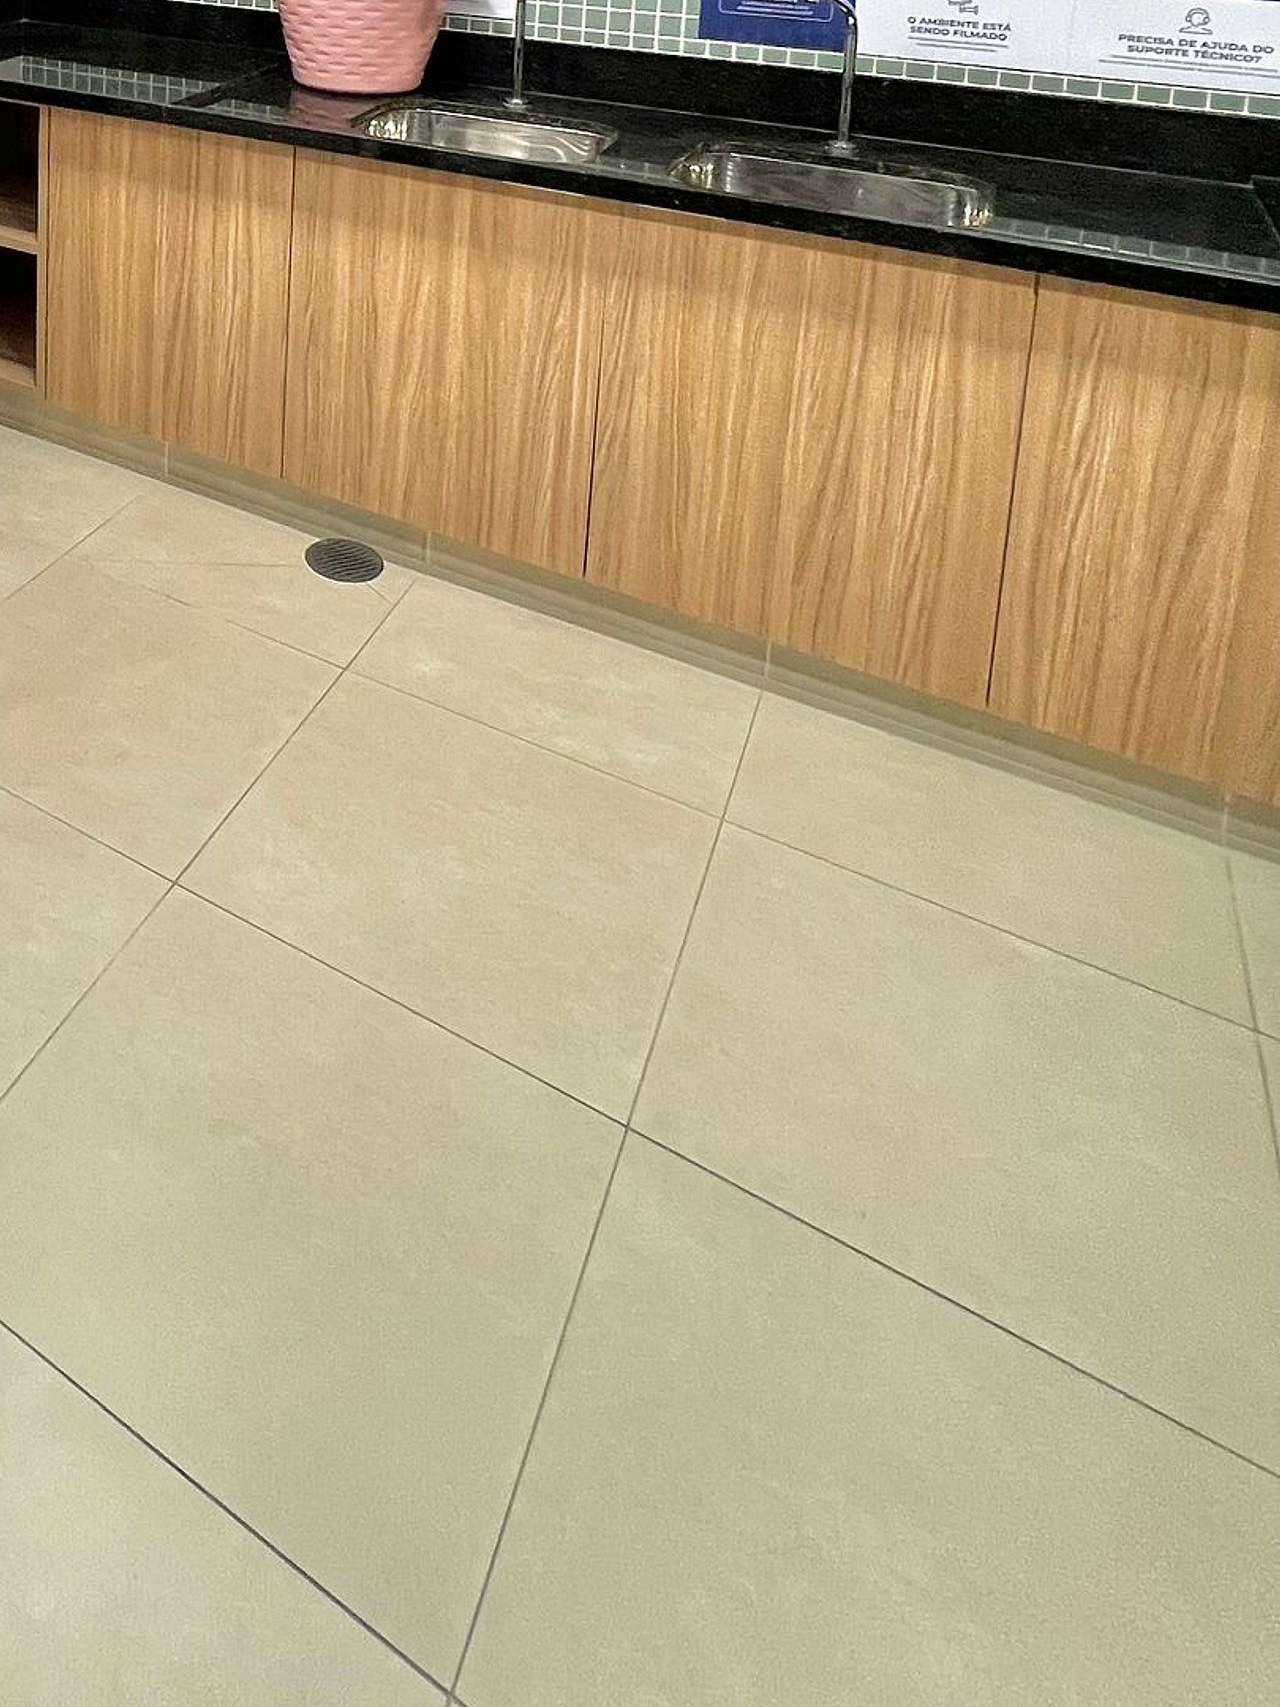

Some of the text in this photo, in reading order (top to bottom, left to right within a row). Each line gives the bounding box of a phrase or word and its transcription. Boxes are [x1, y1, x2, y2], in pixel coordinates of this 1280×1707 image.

[907, 16, 1011, 32] O AMBIENTE ESTÁ
[910, 26, 1007, 41] SENDO FILMADO
[1118, 34, 1275, 54] PRECISA DE AJUDA DO
[1127, 44, 1262, 63] SUPORTE TÉCNICO?
